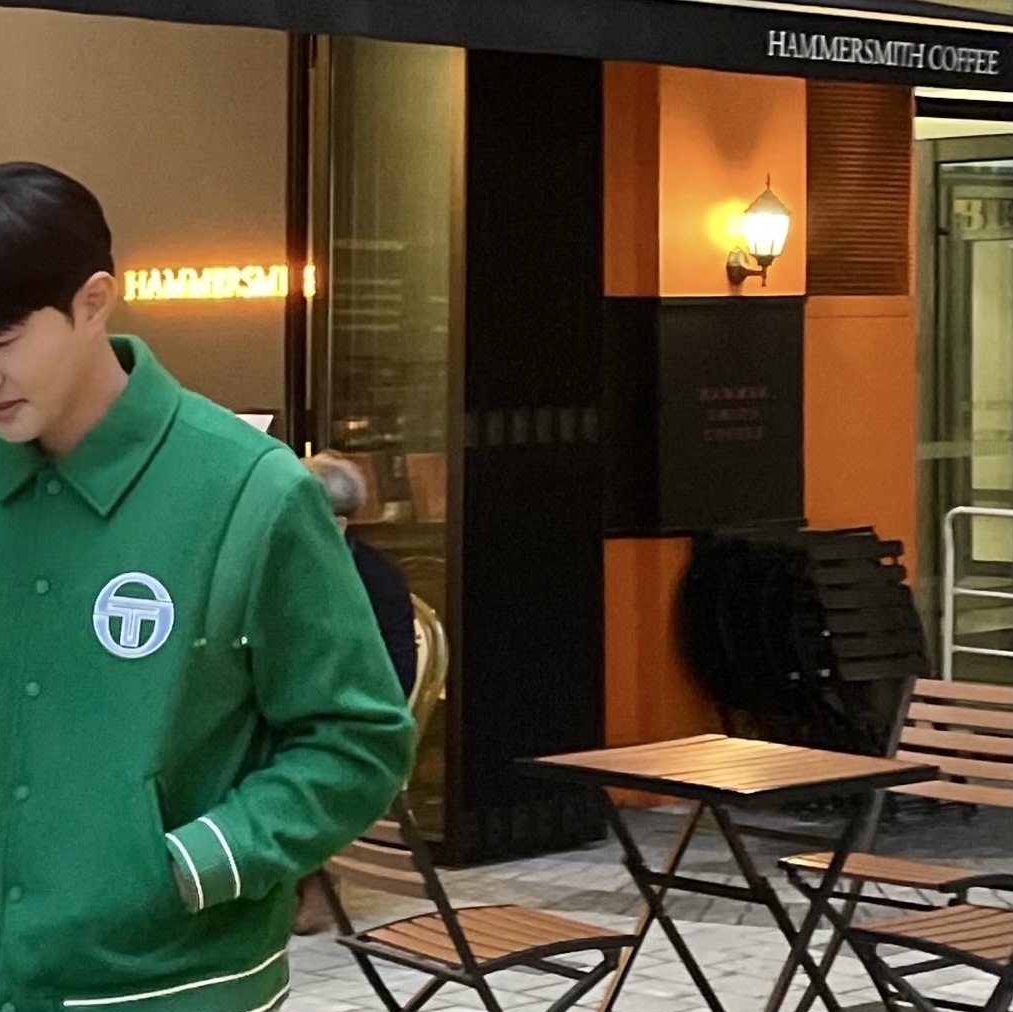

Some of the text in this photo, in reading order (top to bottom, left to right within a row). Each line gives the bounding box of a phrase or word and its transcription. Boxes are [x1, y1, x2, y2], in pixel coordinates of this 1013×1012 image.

[767, 30, 1000, 75] HAMMERSMITH COFFEE
[123, 264, 316, 301] HAMMERSMI
